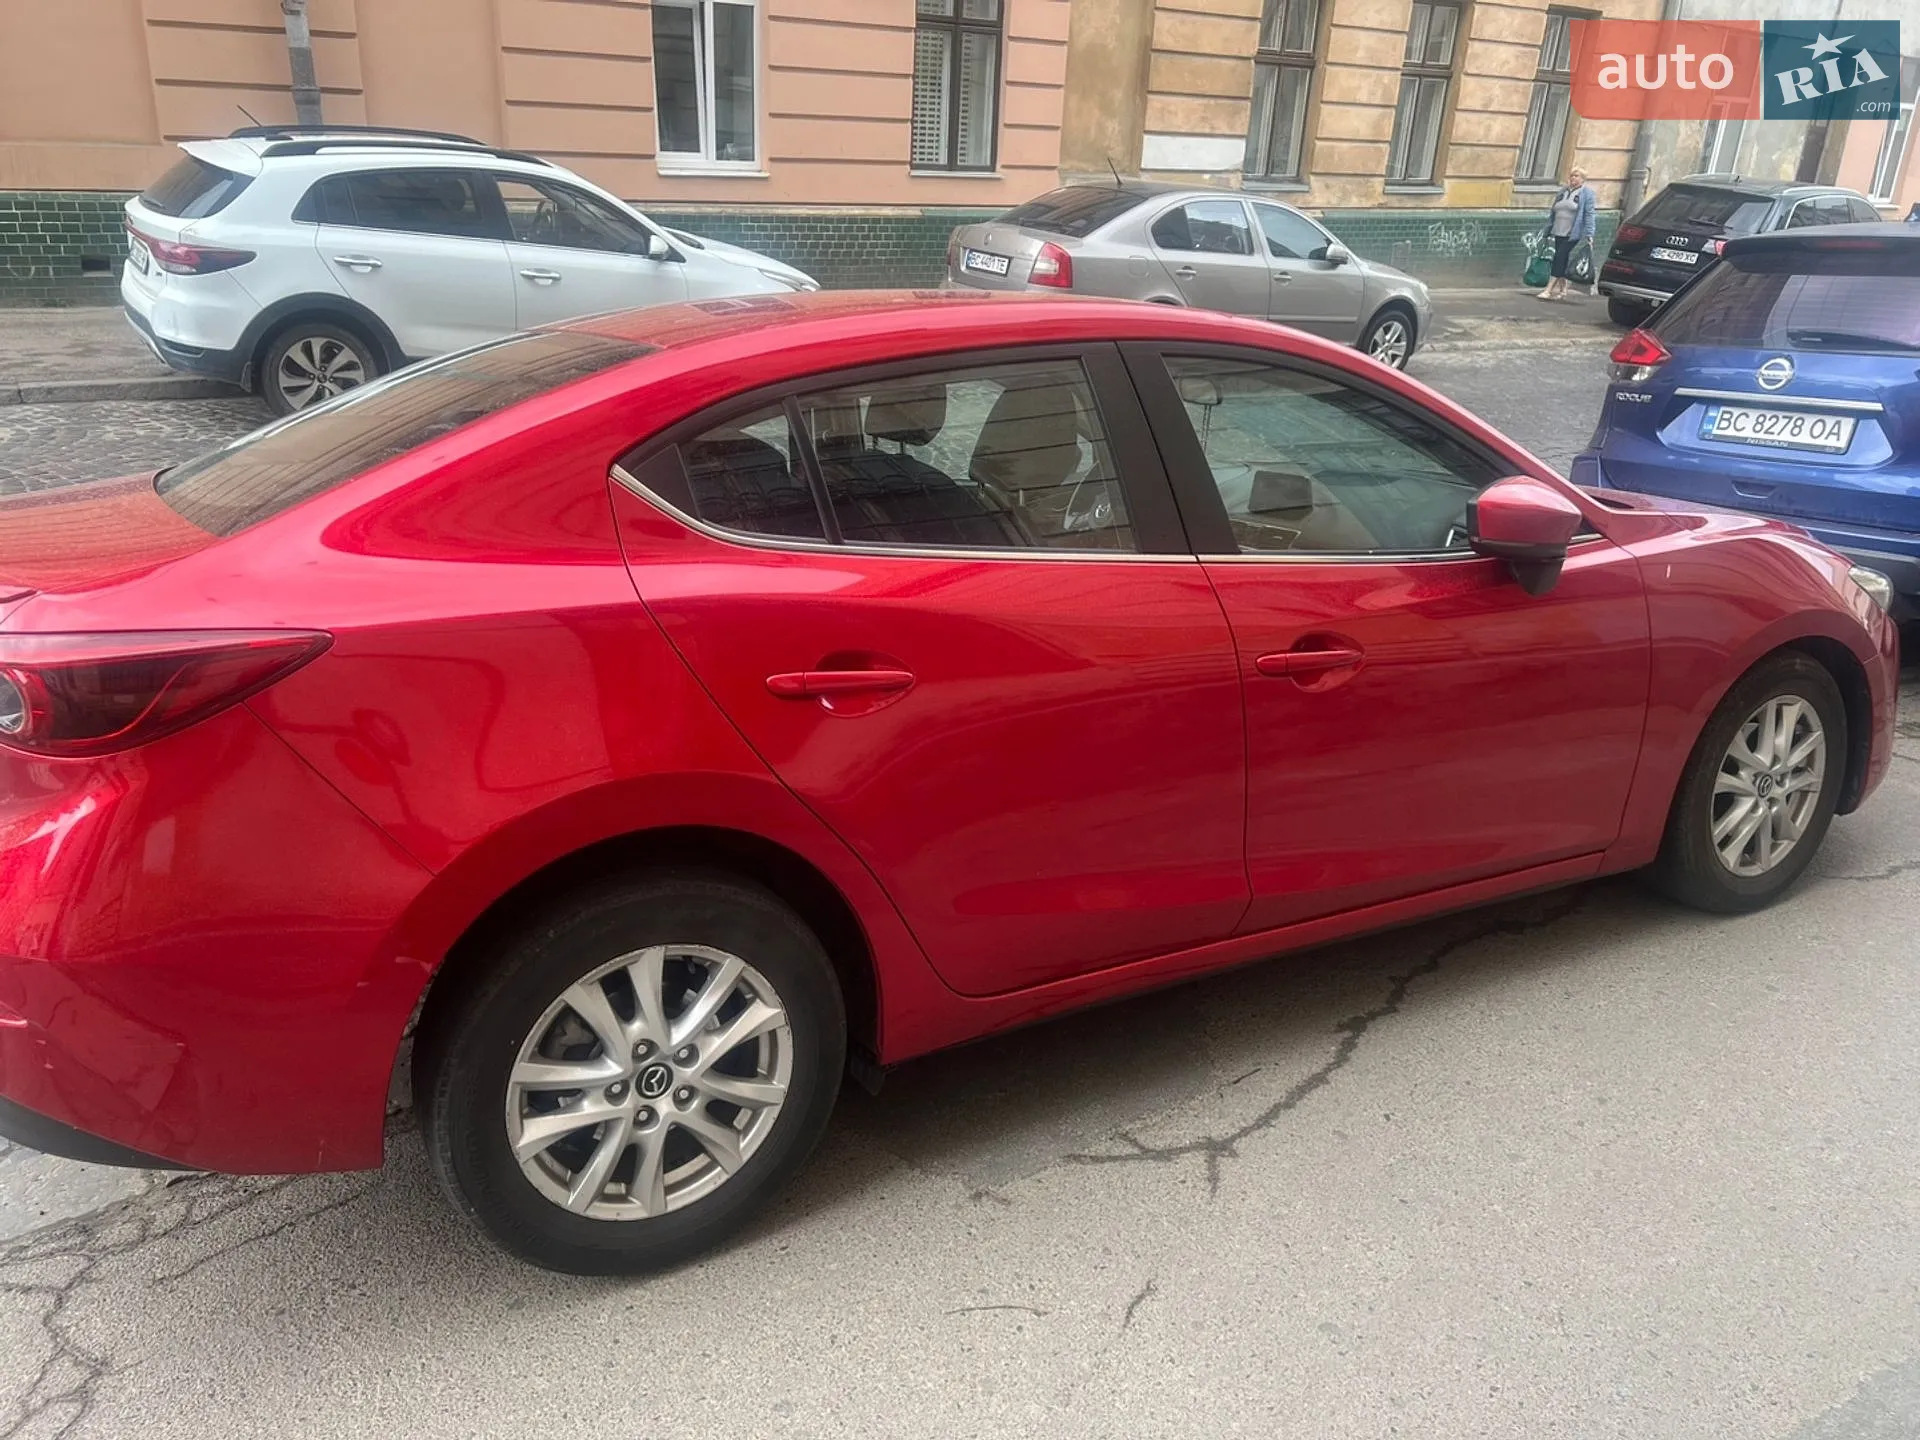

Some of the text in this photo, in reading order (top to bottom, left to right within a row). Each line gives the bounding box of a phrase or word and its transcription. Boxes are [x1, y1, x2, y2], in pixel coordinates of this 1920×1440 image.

[1715, 410, 1842, 442] BC 8278 OA
